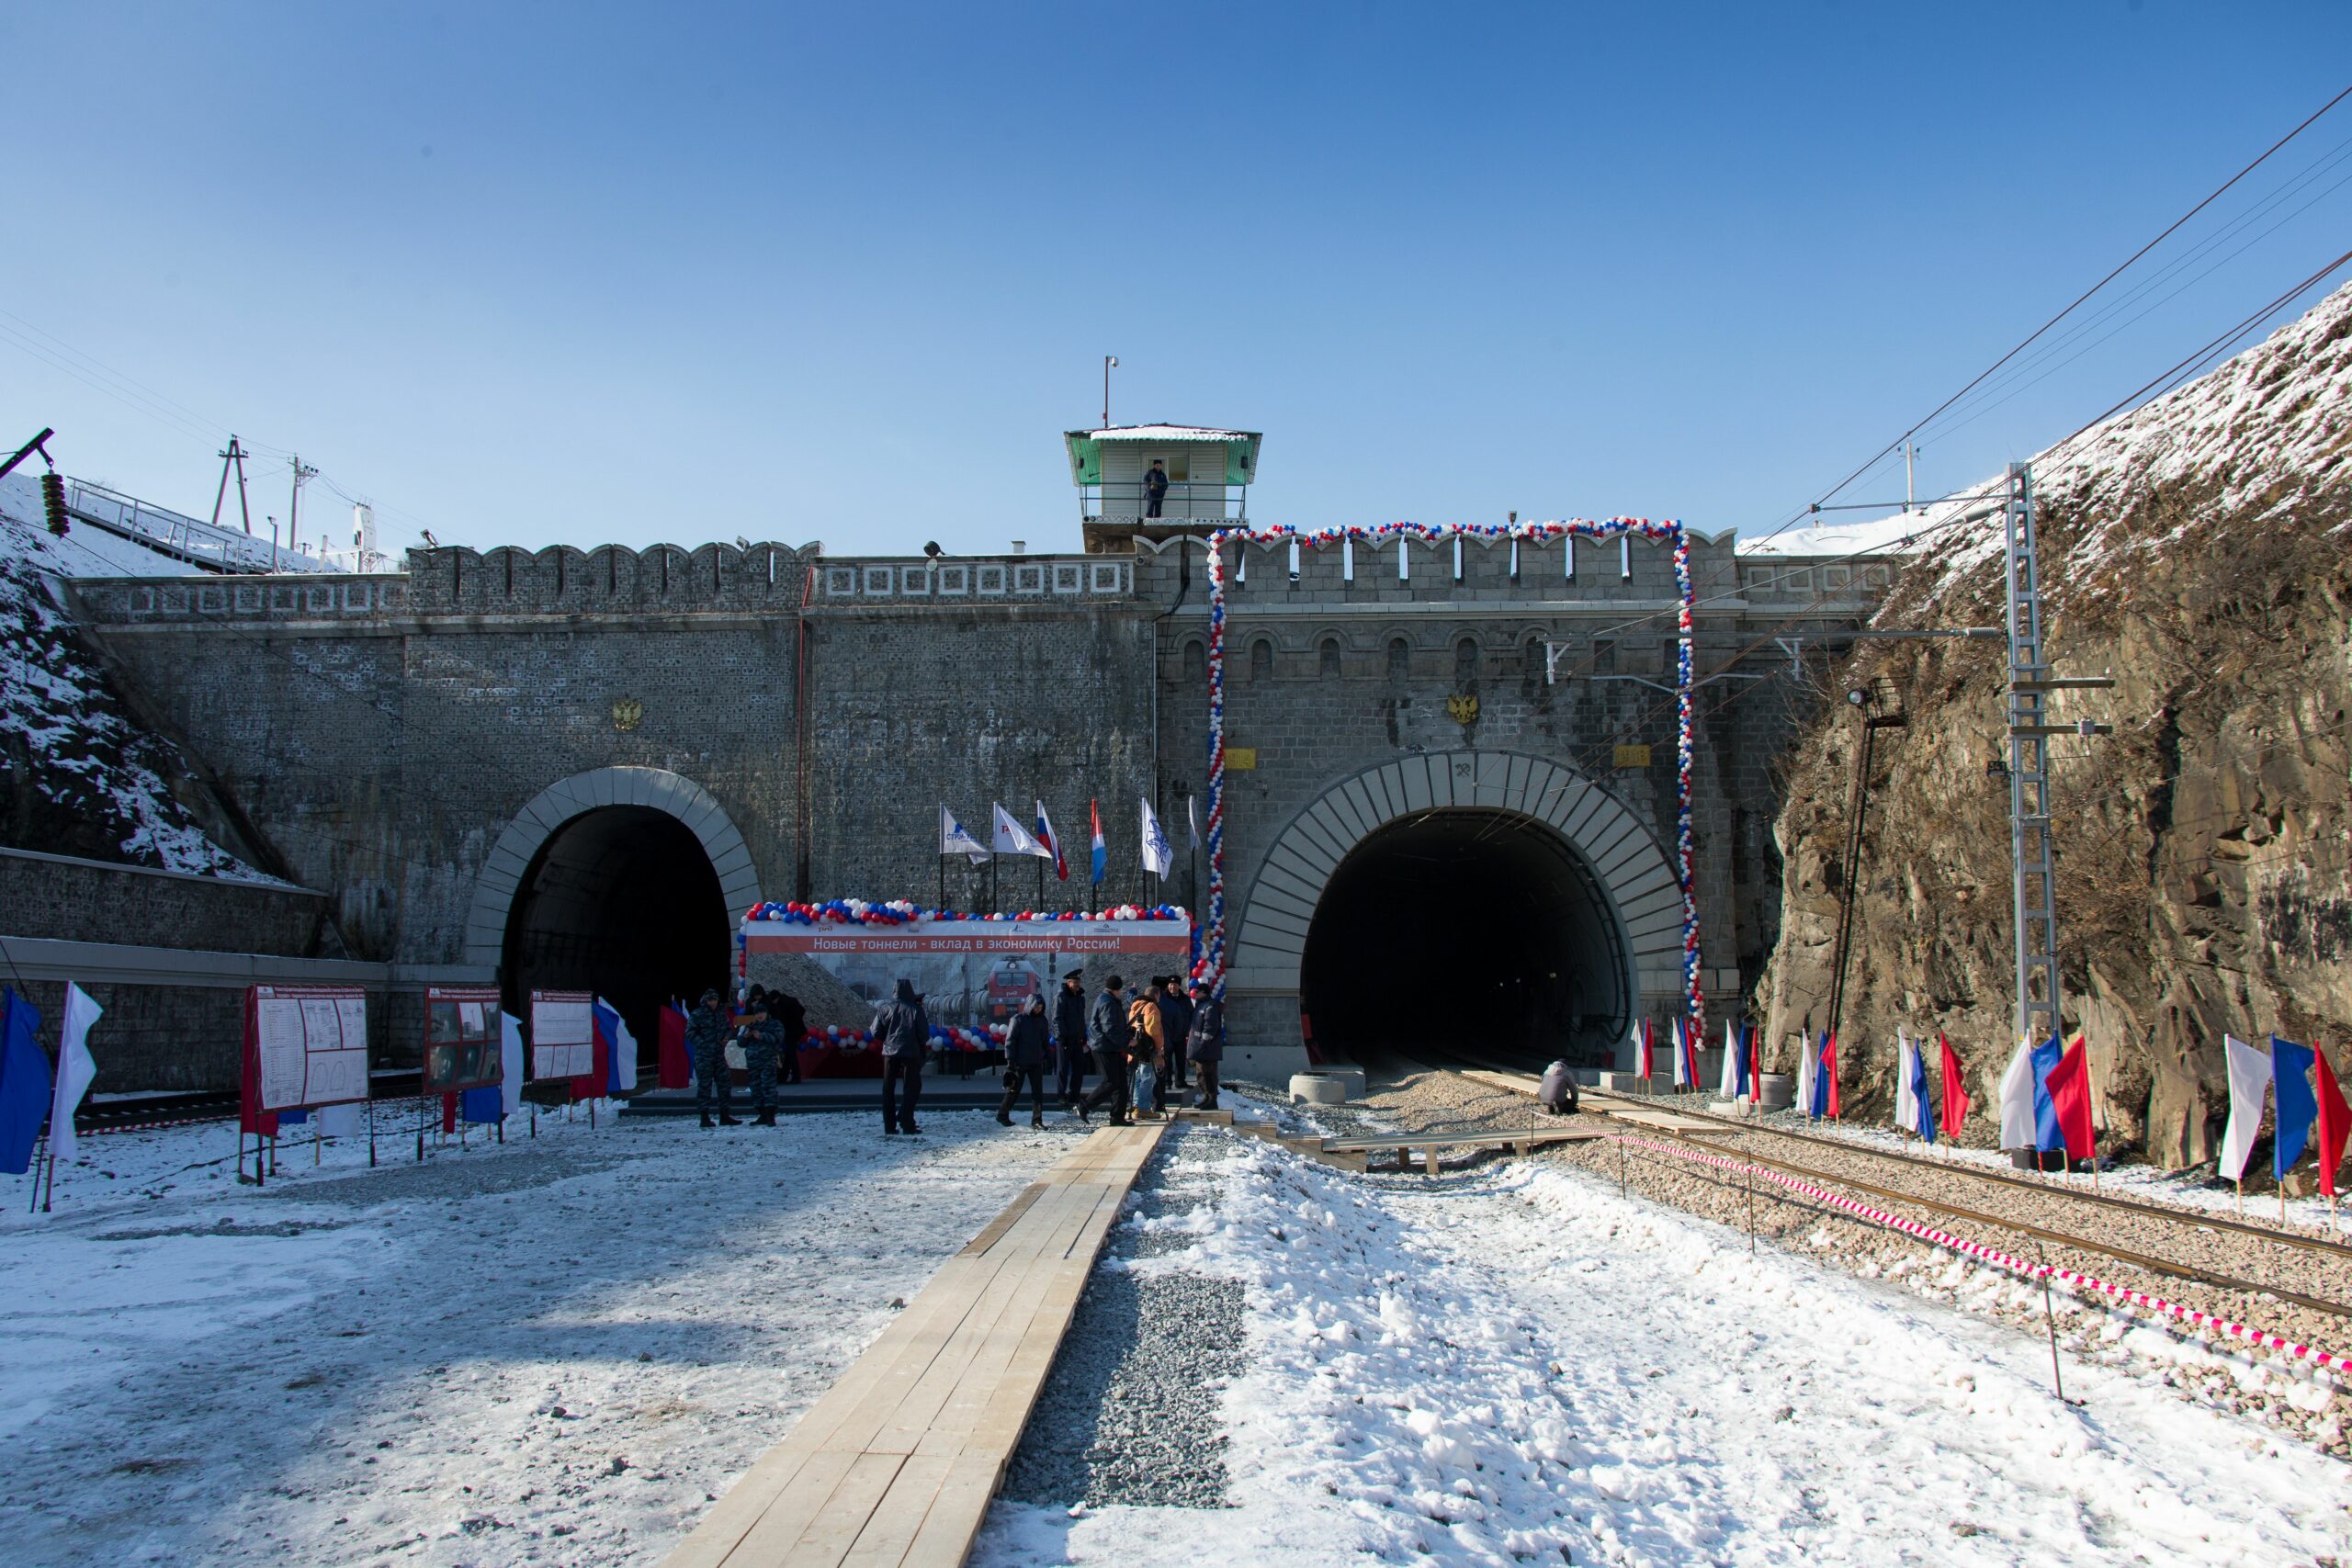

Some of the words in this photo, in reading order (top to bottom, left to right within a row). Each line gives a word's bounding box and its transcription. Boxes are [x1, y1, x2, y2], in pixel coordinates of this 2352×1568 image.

[813, 938, 856, 950] Новые
[861, 940, 917, 950] тоннели
[931, 940, 971, 952] вклад
[976, 940, 983, 949] в
[989, 940, 1062, 953] экономику
[1067, 937, 1120, 950] России!
